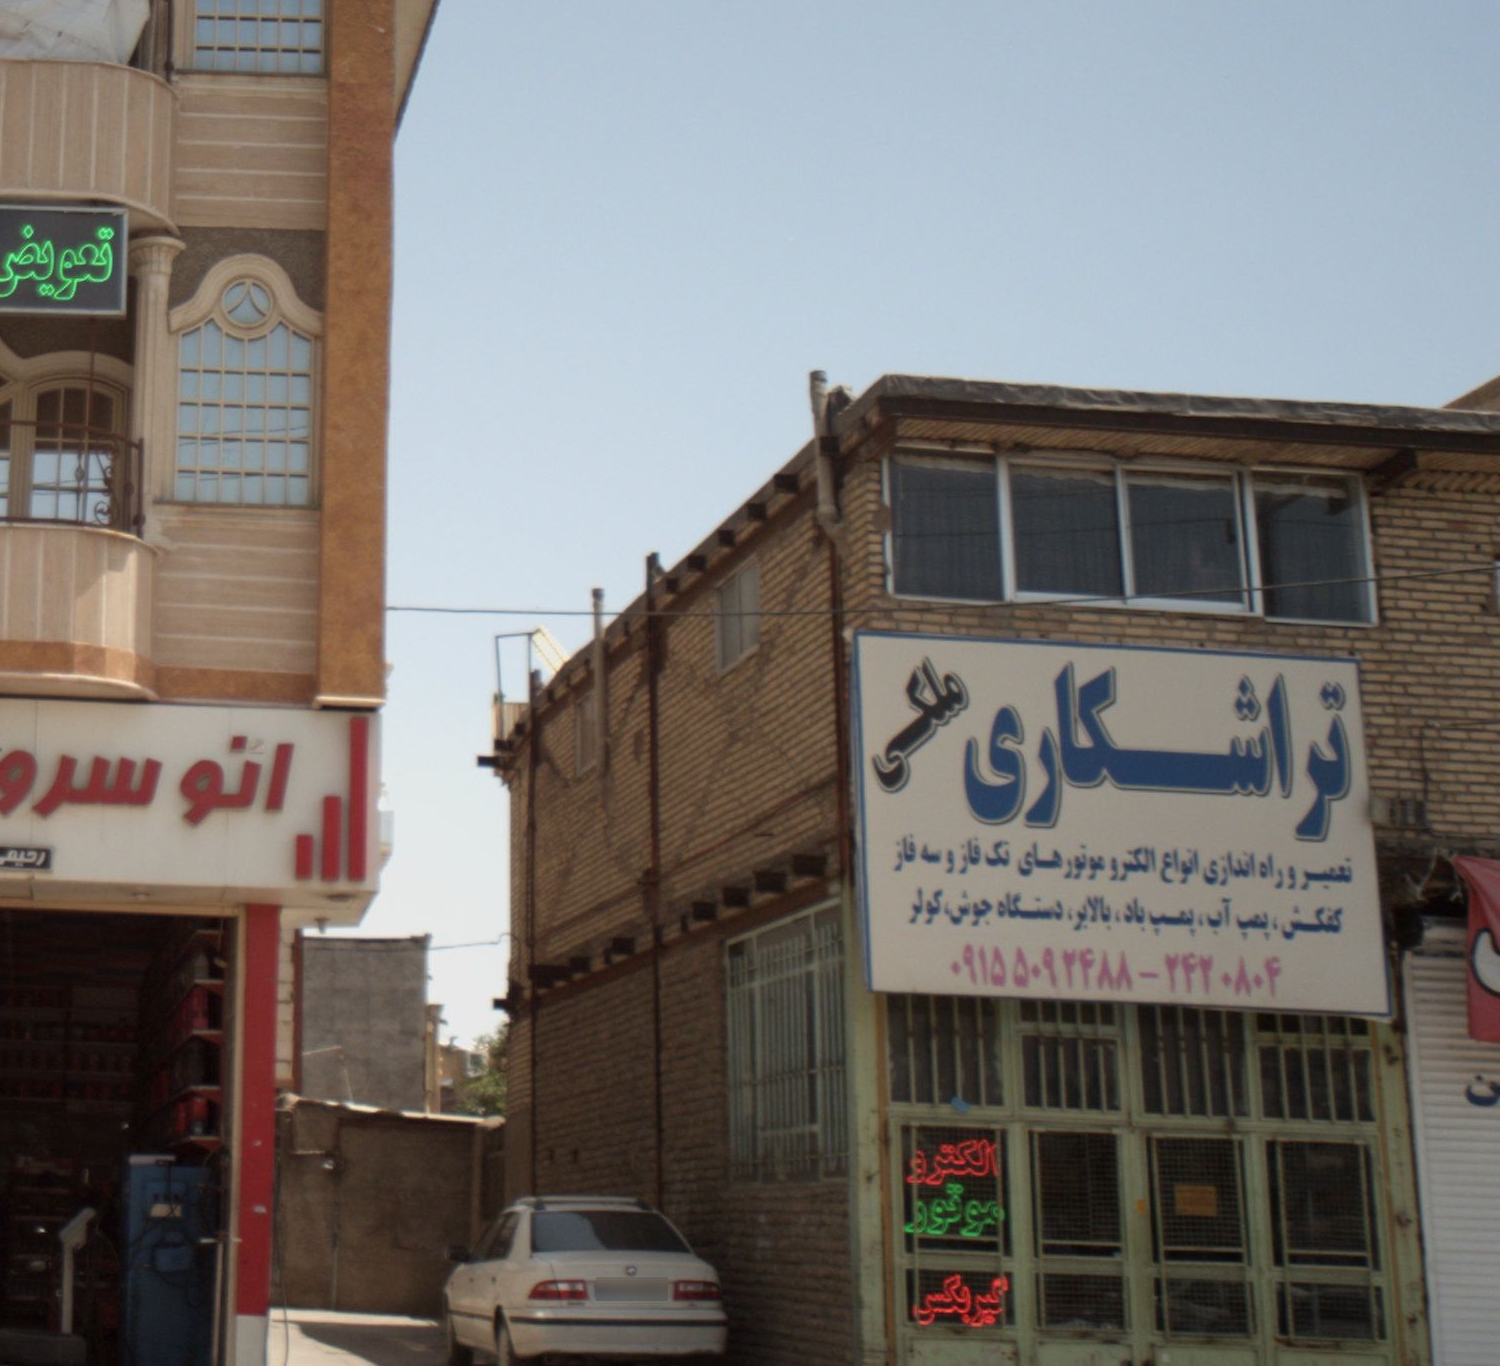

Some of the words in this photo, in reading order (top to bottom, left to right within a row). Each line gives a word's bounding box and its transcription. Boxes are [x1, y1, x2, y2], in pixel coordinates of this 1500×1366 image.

[872, 655, 970, 793] ملکی
[962, 660, 1352, 843] تراشکاری
[893, 833, 917, 872] فاز
[920, 843, 942, 864] سه
[946, 849, 955, 874] و
[959, 836, 982, 875] فاز
[985, 840, 1011, 867] تک
[1160, 848, 1199, 884] انواع
[1203, 850, 1256, 886] اندازی
[1258, 852, 1284, 889] راه
[1287, 865, 1297, 890] و
[1301, 857, 1352, 890] تعمیر
[908, 888, 943, 924] کولر
[997, 891, 1063, 921] دستگاه
[1073, 894, 1111, 932] بالابر
[1123, 897, 1145, 932] باد
[1150, 908, 1194, 936] پمپ
[1206, 897, 1232, 935] آب
[1281, 905, 1343, 940] کفکش
[1236, 910, 1269, 940] پمپ
[906, 1138, 998, 1185] الکترو
[903, 1183, 1005, 1237] موتور
